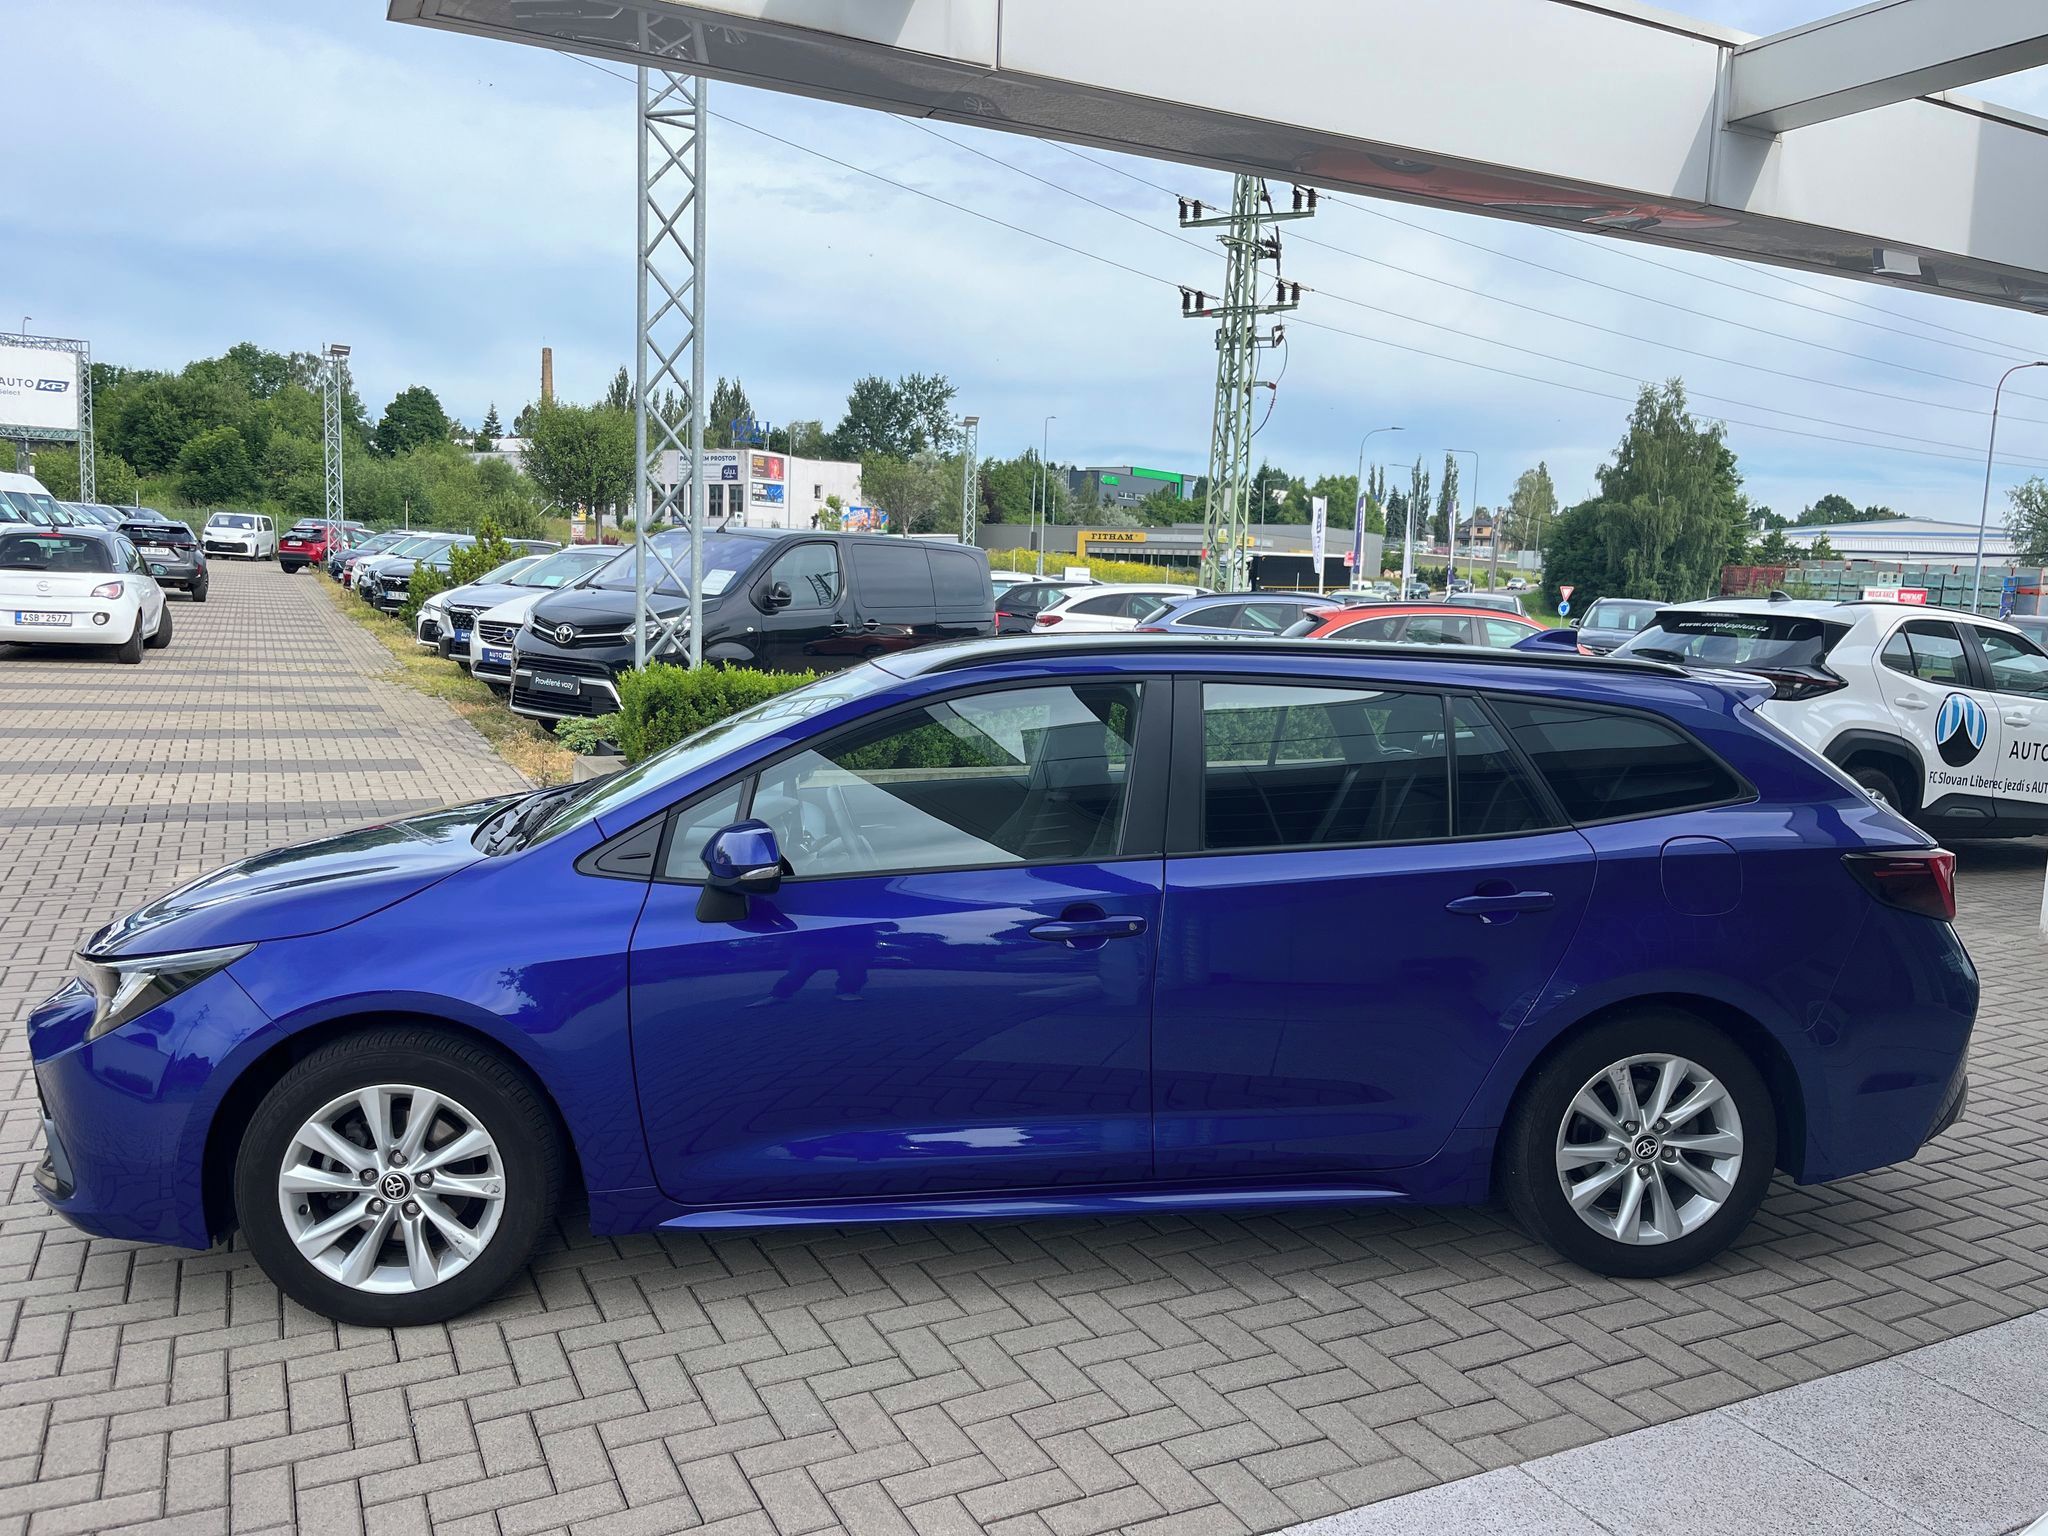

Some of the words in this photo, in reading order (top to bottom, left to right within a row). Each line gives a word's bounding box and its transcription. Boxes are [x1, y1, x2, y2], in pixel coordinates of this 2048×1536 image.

[0, 377, 34, 388] AUTO
[1091, 532, 1134, 541] FITHAM
[23, 613, 39, 622] 4SB
[46, 614, 68, 622] 2577
[1679, 622, 1769, 632] www.autokpplus.cz
[489, 651, 502, 659] AUTO
[535, 676, 561, 688] Prověřené
[561, 680, 574, 690] vozy
[1929, 771, 1938, 783] FC
[1939, 772, 1968, 786] Slovan
[1970, 775, 2002, 790] Liberec
[2003, 778, 2025, 793] jezdí
[2026, 783, 2031, 792] s
